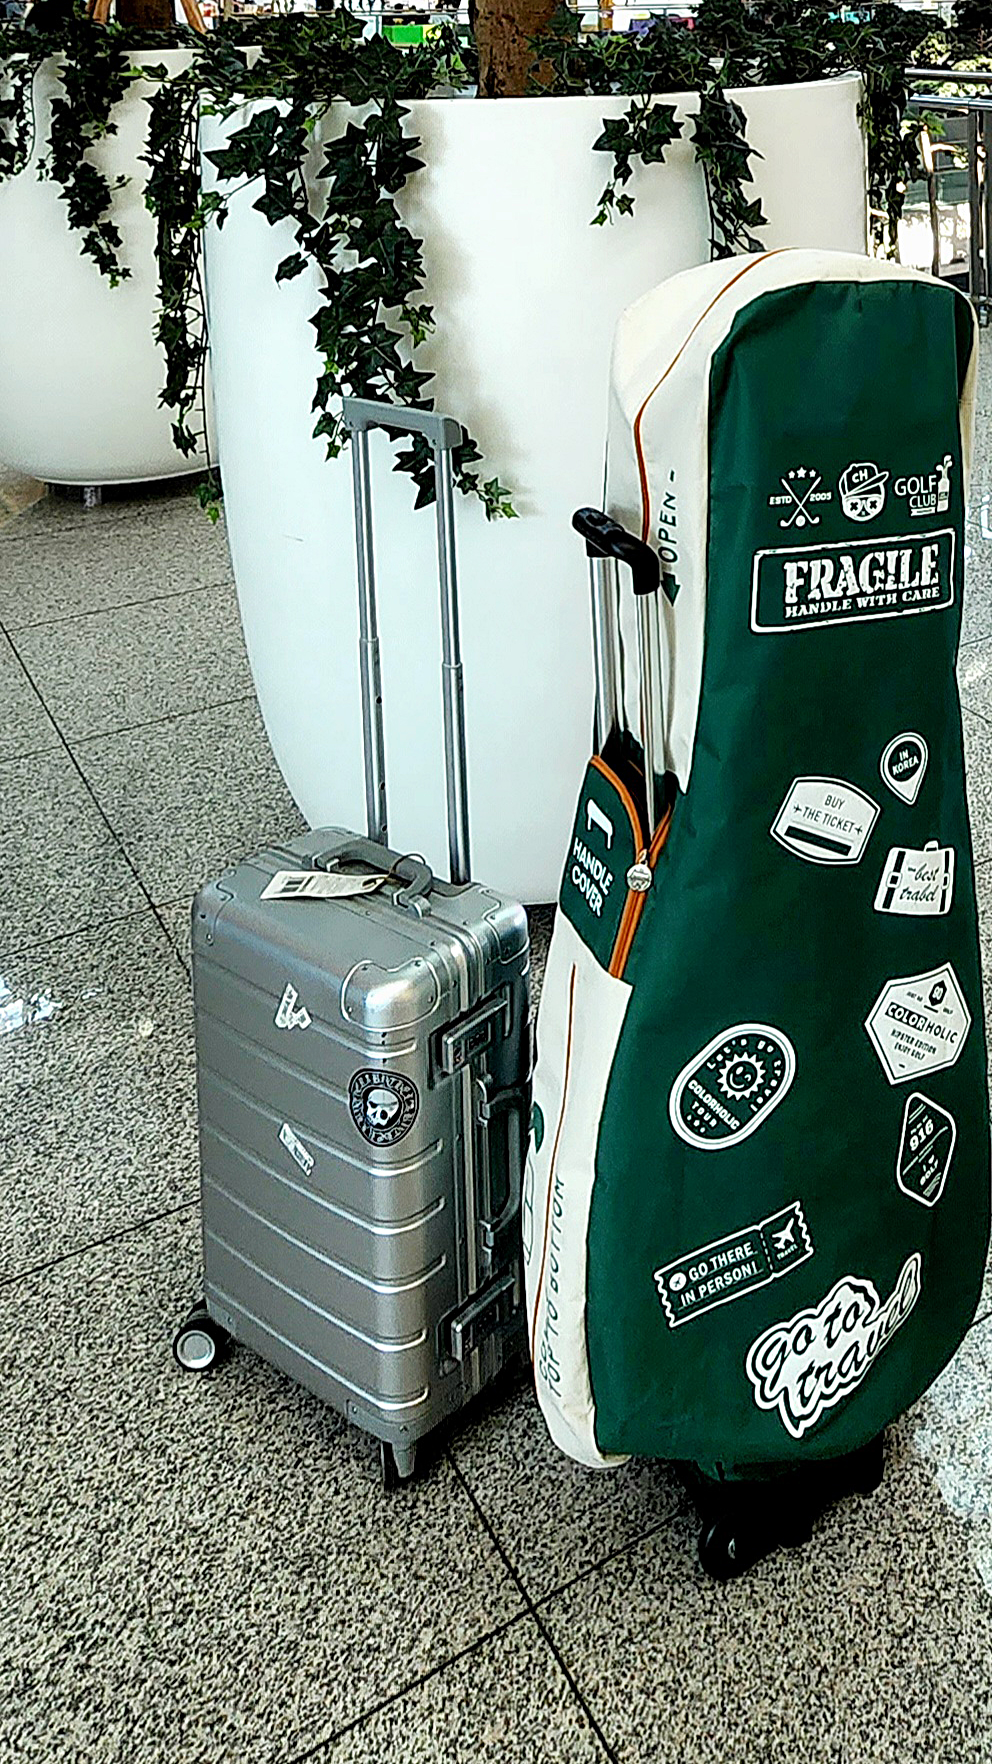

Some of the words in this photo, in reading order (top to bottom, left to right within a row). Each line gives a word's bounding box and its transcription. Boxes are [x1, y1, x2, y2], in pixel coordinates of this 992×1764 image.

[769, 495, 792, 506] ESTD
[895, 475, 937, 496] GOLF
[909, 494, 937, 508] CLUB
[657, 491, 679, 563] OPEN
[783, 544, 939, 604] FRAGILE
[785, 599, 852, 618] HANDLE
[856, 592, 897, 609] WITH
[902, 586, 940, 603] CARE
[892, 754, 919, 776] KOREA
[899, 748, 909, 761] IN
[824, 794, 846, 811] BUY
[802, 806, 823, 823] THE
[822, 812, 856, 834] TICKET
[573, 837, 613, 896] HANDLE
[572, 865, 602, 917] COVER
[886, 1003, 959, 1044] COLORHOLIC
[687, 1079, 741, 1131] COLORHOLIC
[691, 1101, 718, 1128] TOUR
[688, 1261, 709, 1283] GO
[709, 1241, 755, 1272] THERE
[679, 1291, 697, 1308] IN
[761, 1323, 816, 1393] go
[823, 1300, 865, 1349] to
[796, 1260, 918, 1409] travel
